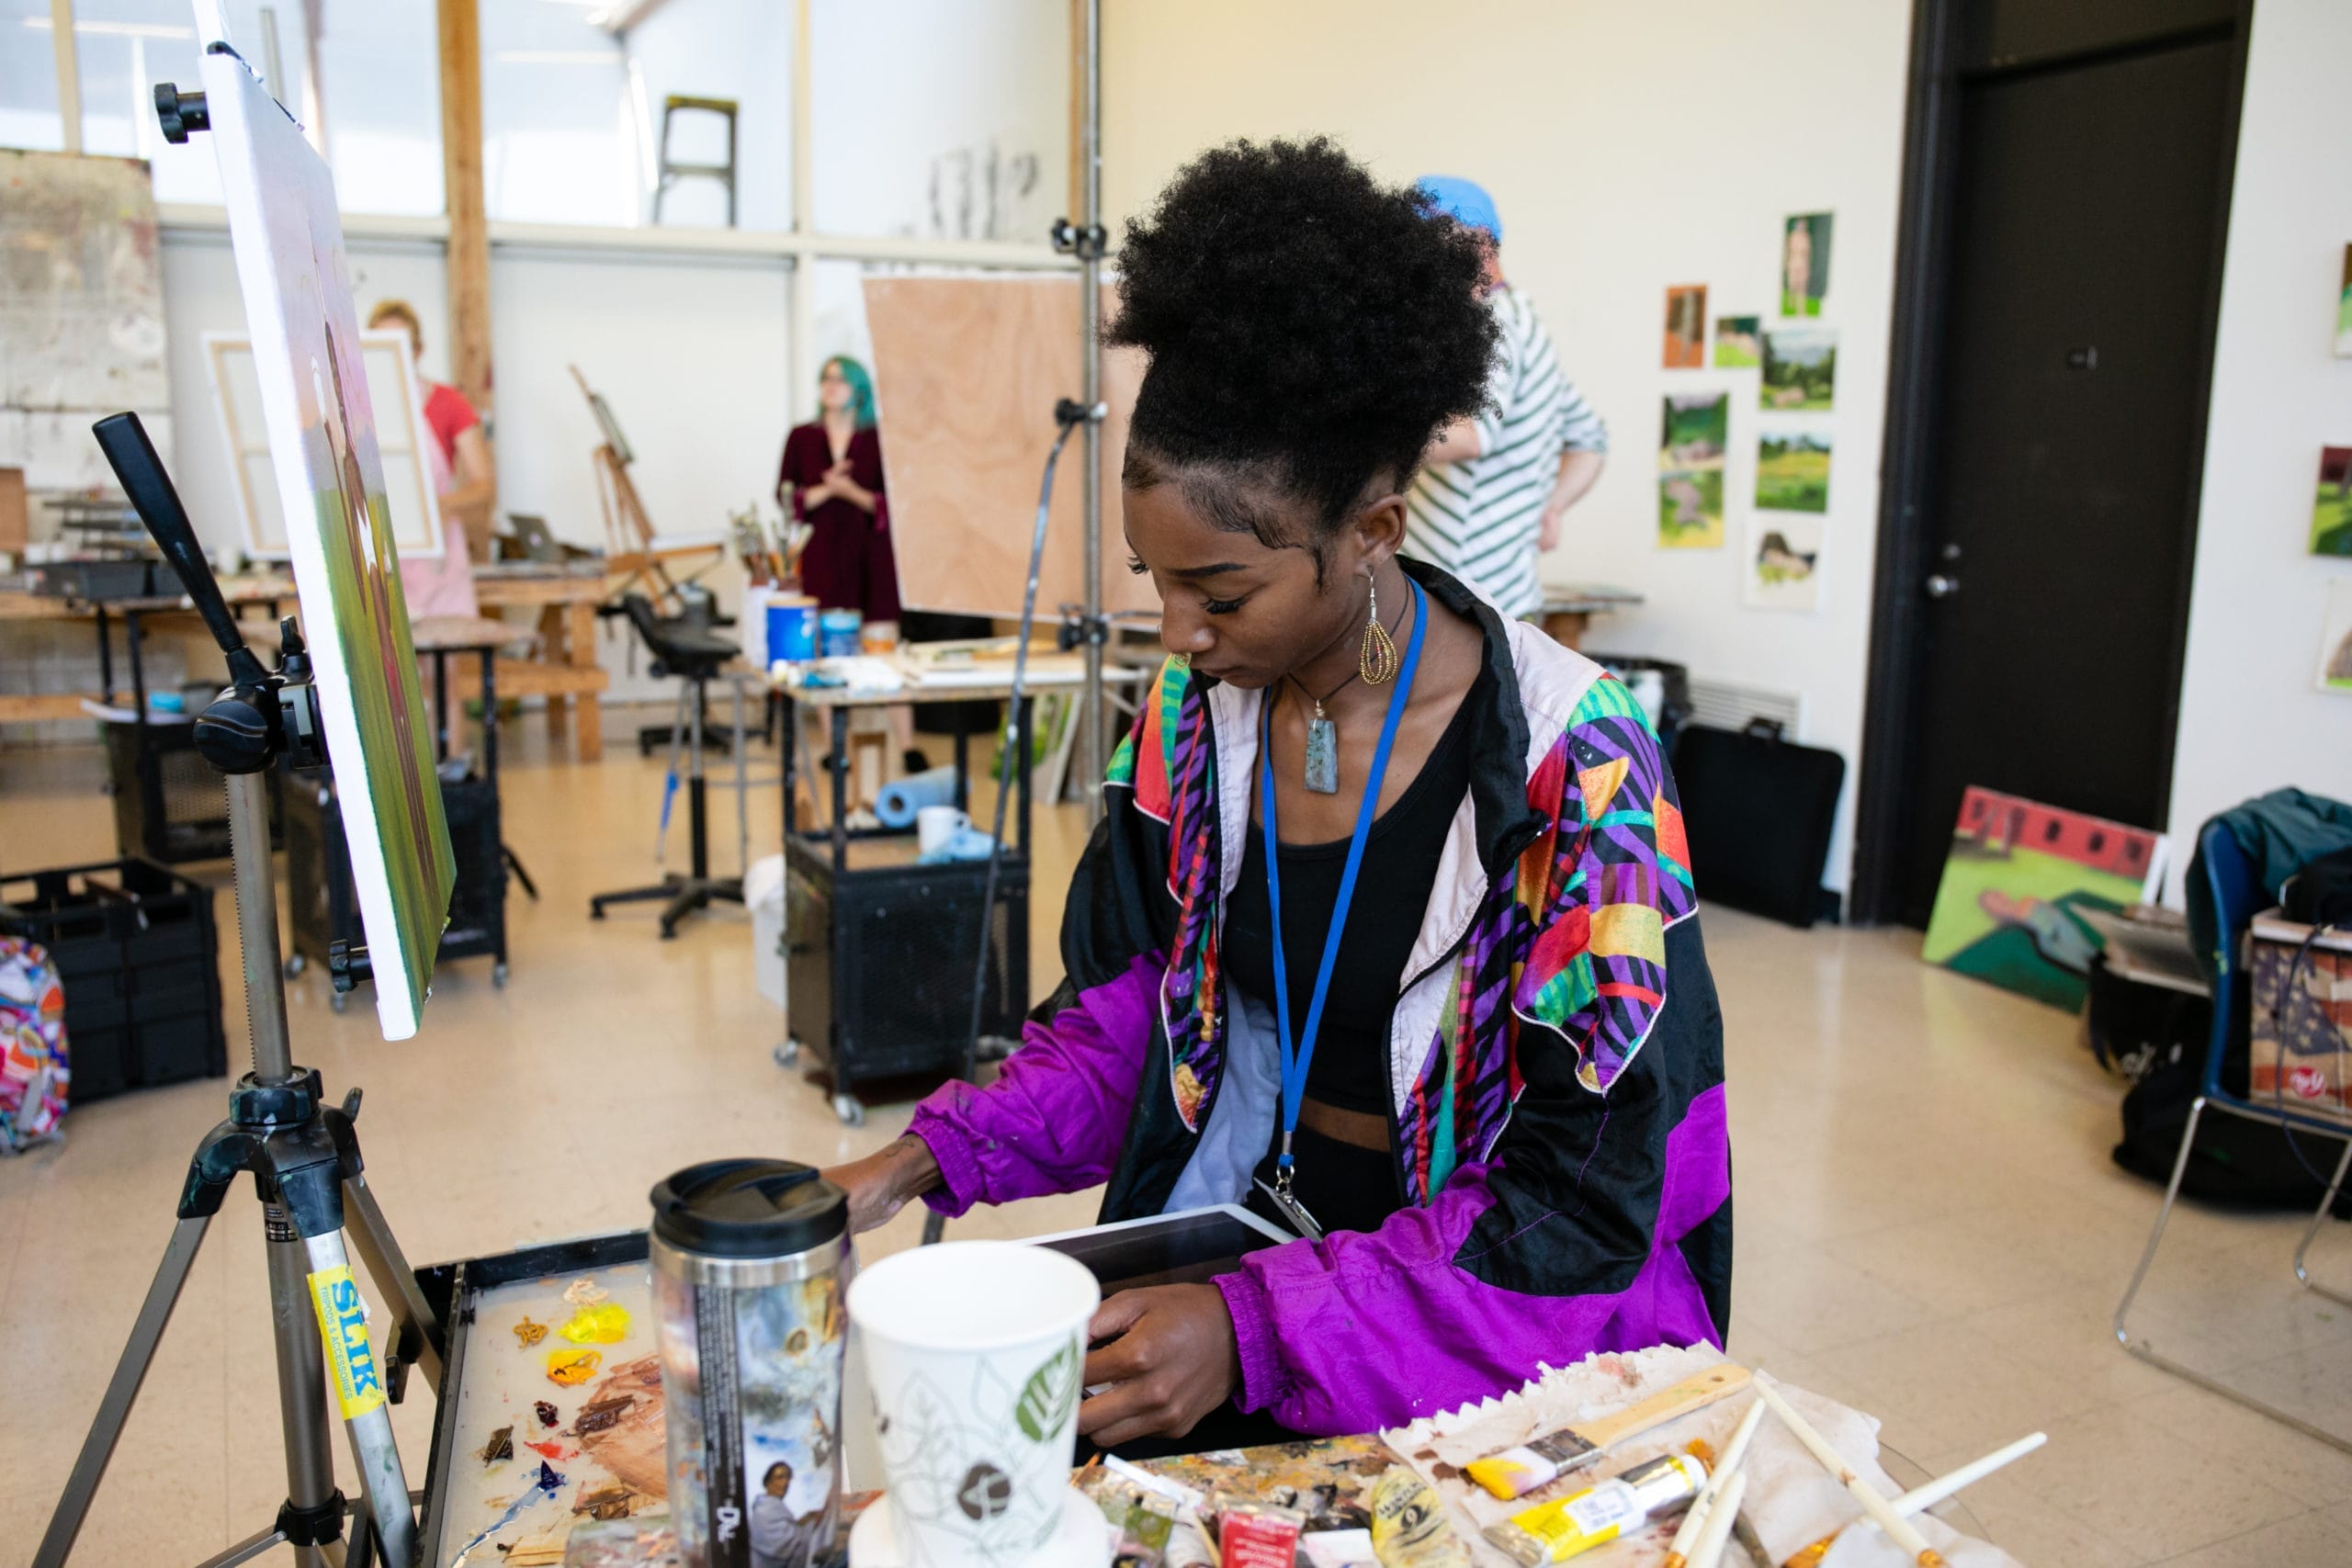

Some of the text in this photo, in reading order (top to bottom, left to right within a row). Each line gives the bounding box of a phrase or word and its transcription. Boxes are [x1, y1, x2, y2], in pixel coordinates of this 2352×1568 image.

[320, 1287, 334, 1325] TRIPODS
[331, 1336, 353, 1400] ACCESSORIES
[332, 1280, 379, 1396] SLIK
